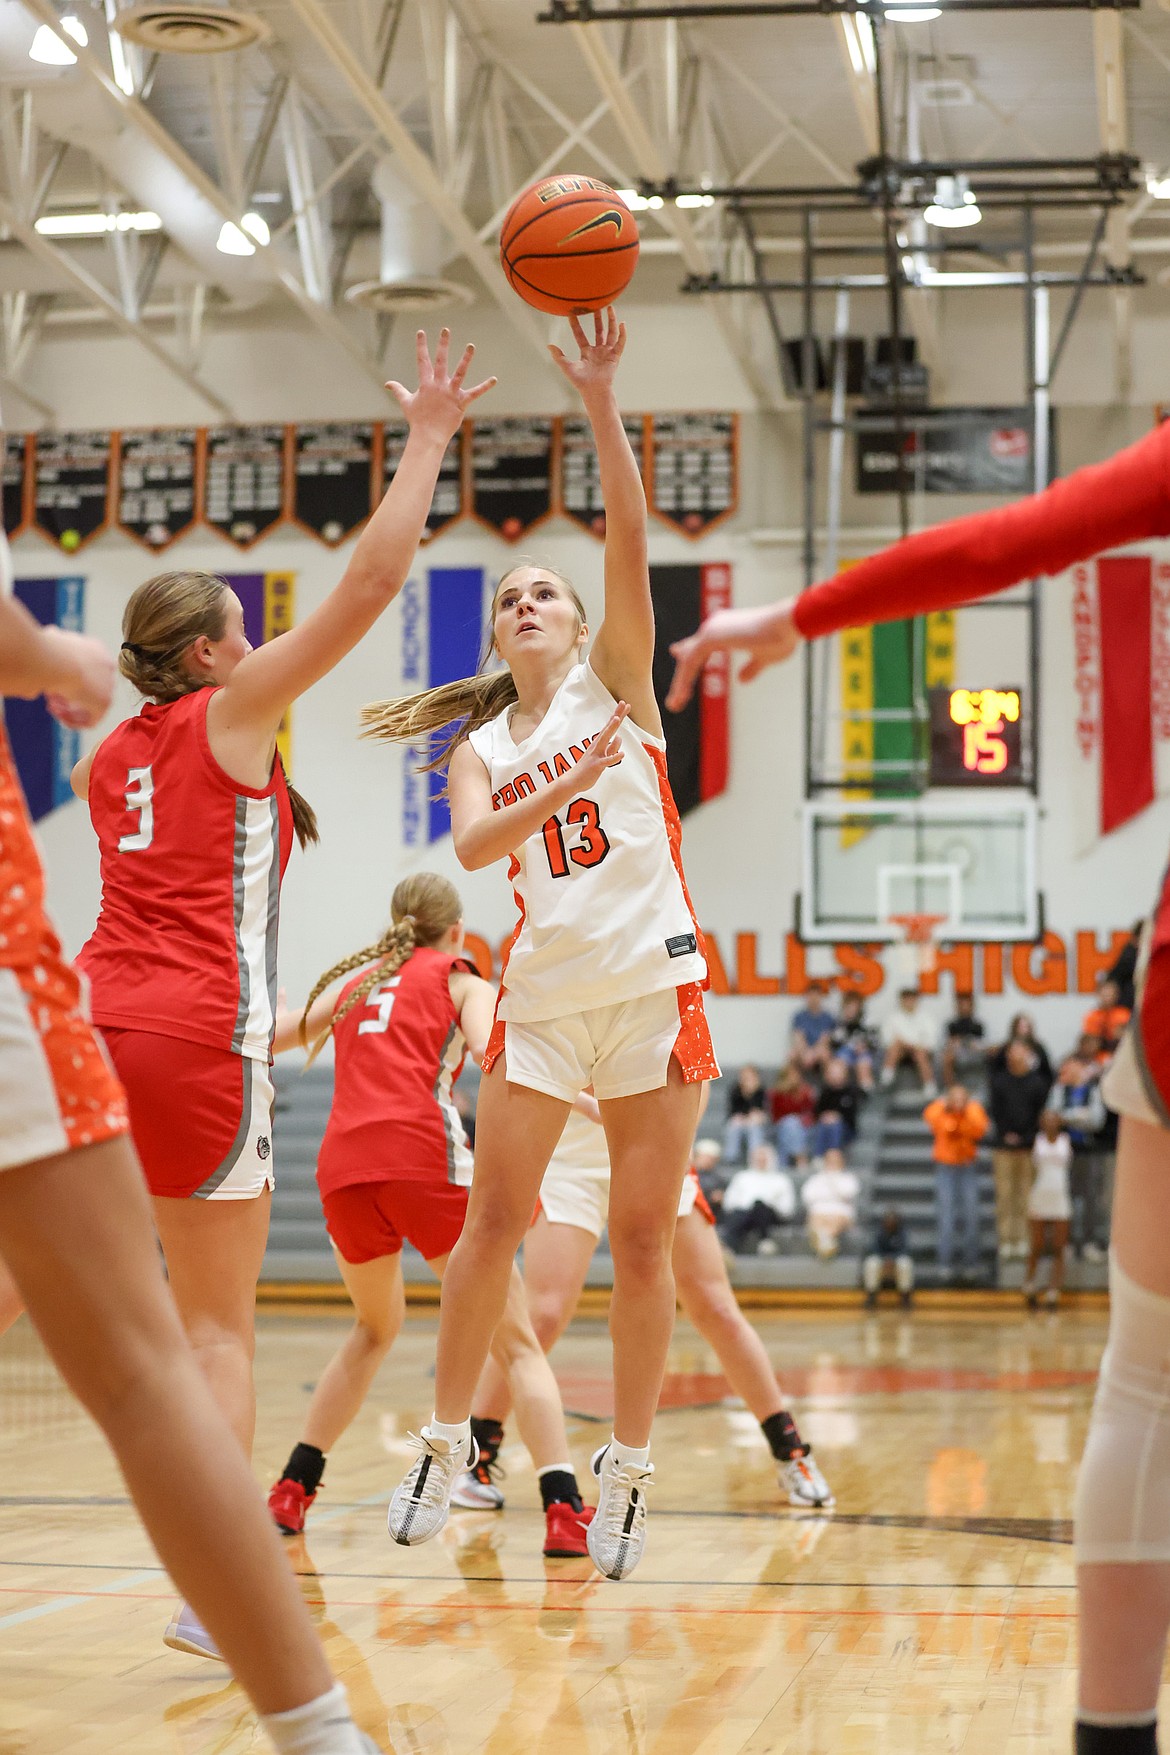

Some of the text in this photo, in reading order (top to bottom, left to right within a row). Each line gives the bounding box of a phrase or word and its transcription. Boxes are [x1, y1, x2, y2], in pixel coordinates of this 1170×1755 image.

[963, 719, 1008, 774] 15
[117, 763, 155, 855] 3
[543, 797, 611, 879] 13
[357, 975, 403, 1038] 5
